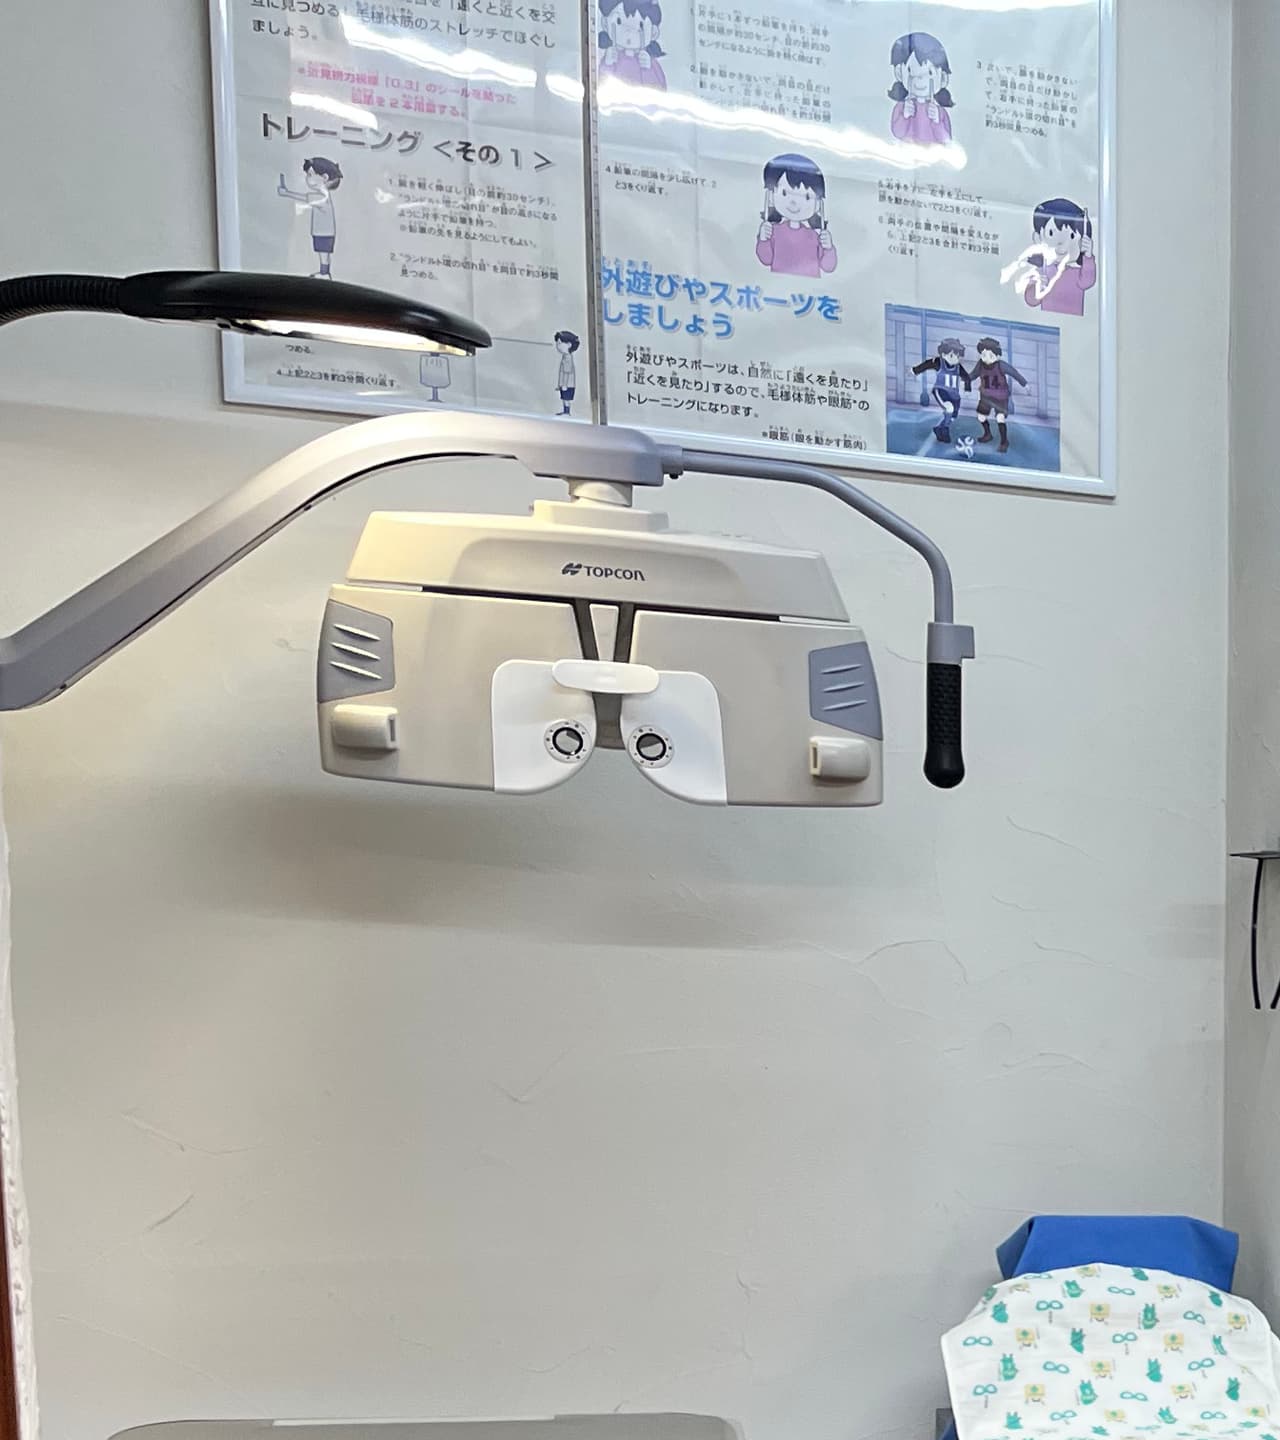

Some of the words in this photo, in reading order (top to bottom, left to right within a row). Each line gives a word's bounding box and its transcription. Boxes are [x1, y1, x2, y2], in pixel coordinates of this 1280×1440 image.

[252, 19, 318, 40] ましょう。
[262, 112, 423, 154] トレーニング
[602, 265, 842, 321] 外遊びやスポーツを
[603, 297, 734, 338] しましょう
[627, 393, 759, 418] トレーニングになります。
[583, 565, 646, 582] TOPCON
